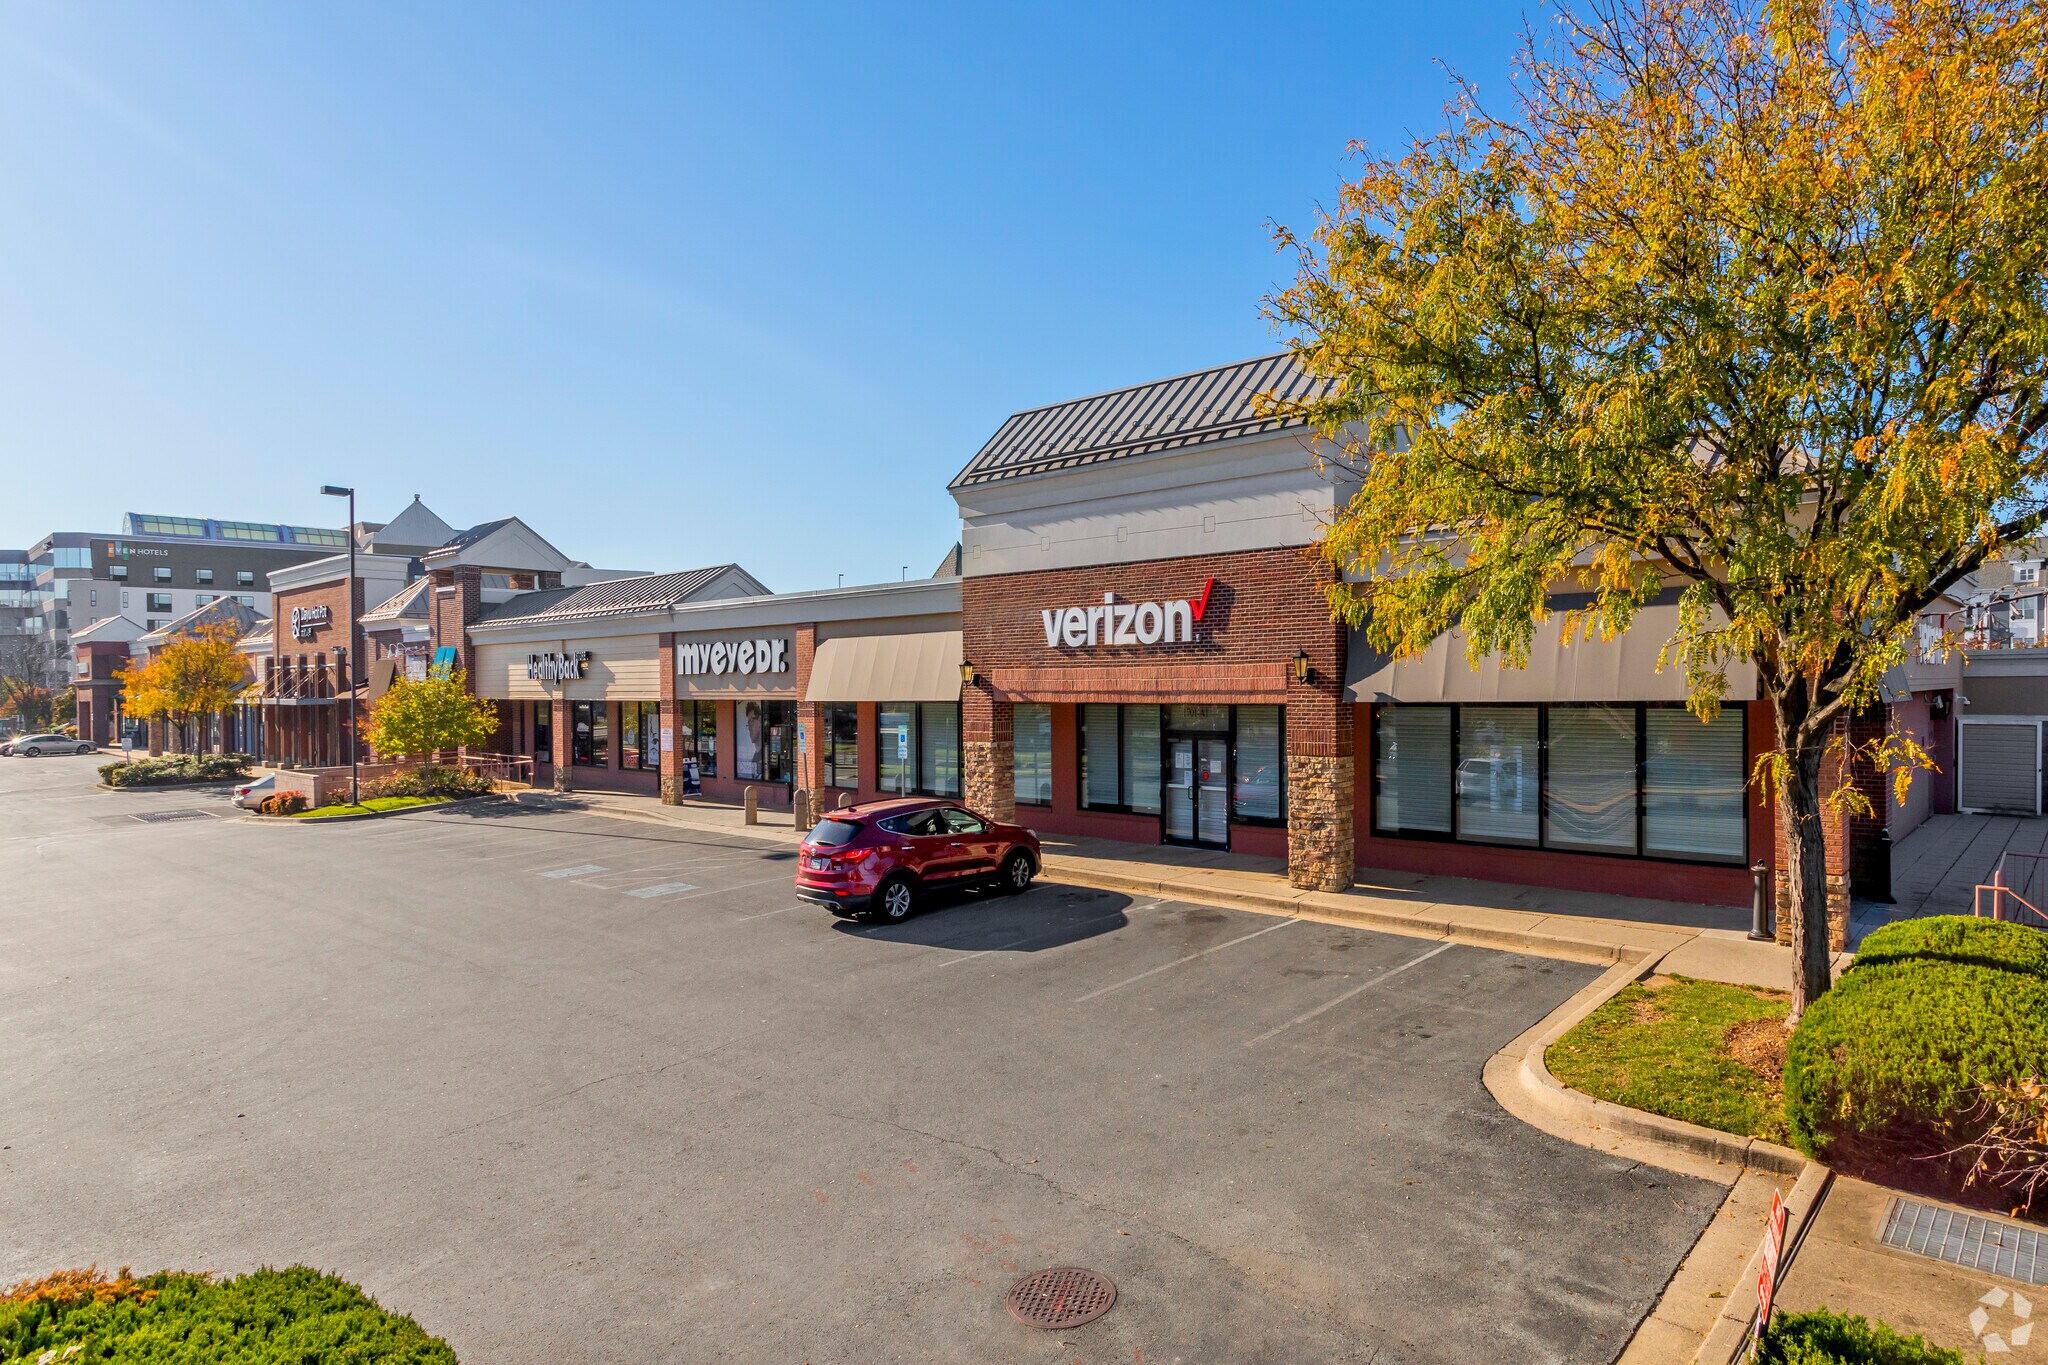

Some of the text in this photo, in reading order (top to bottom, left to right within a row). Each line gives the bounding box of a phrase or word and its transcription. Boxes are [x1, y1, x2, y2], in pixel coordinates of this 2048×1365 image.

[108, 545, 169, 556] EVEN HOTELS
[1042, 592, 1192, 647] verizon
